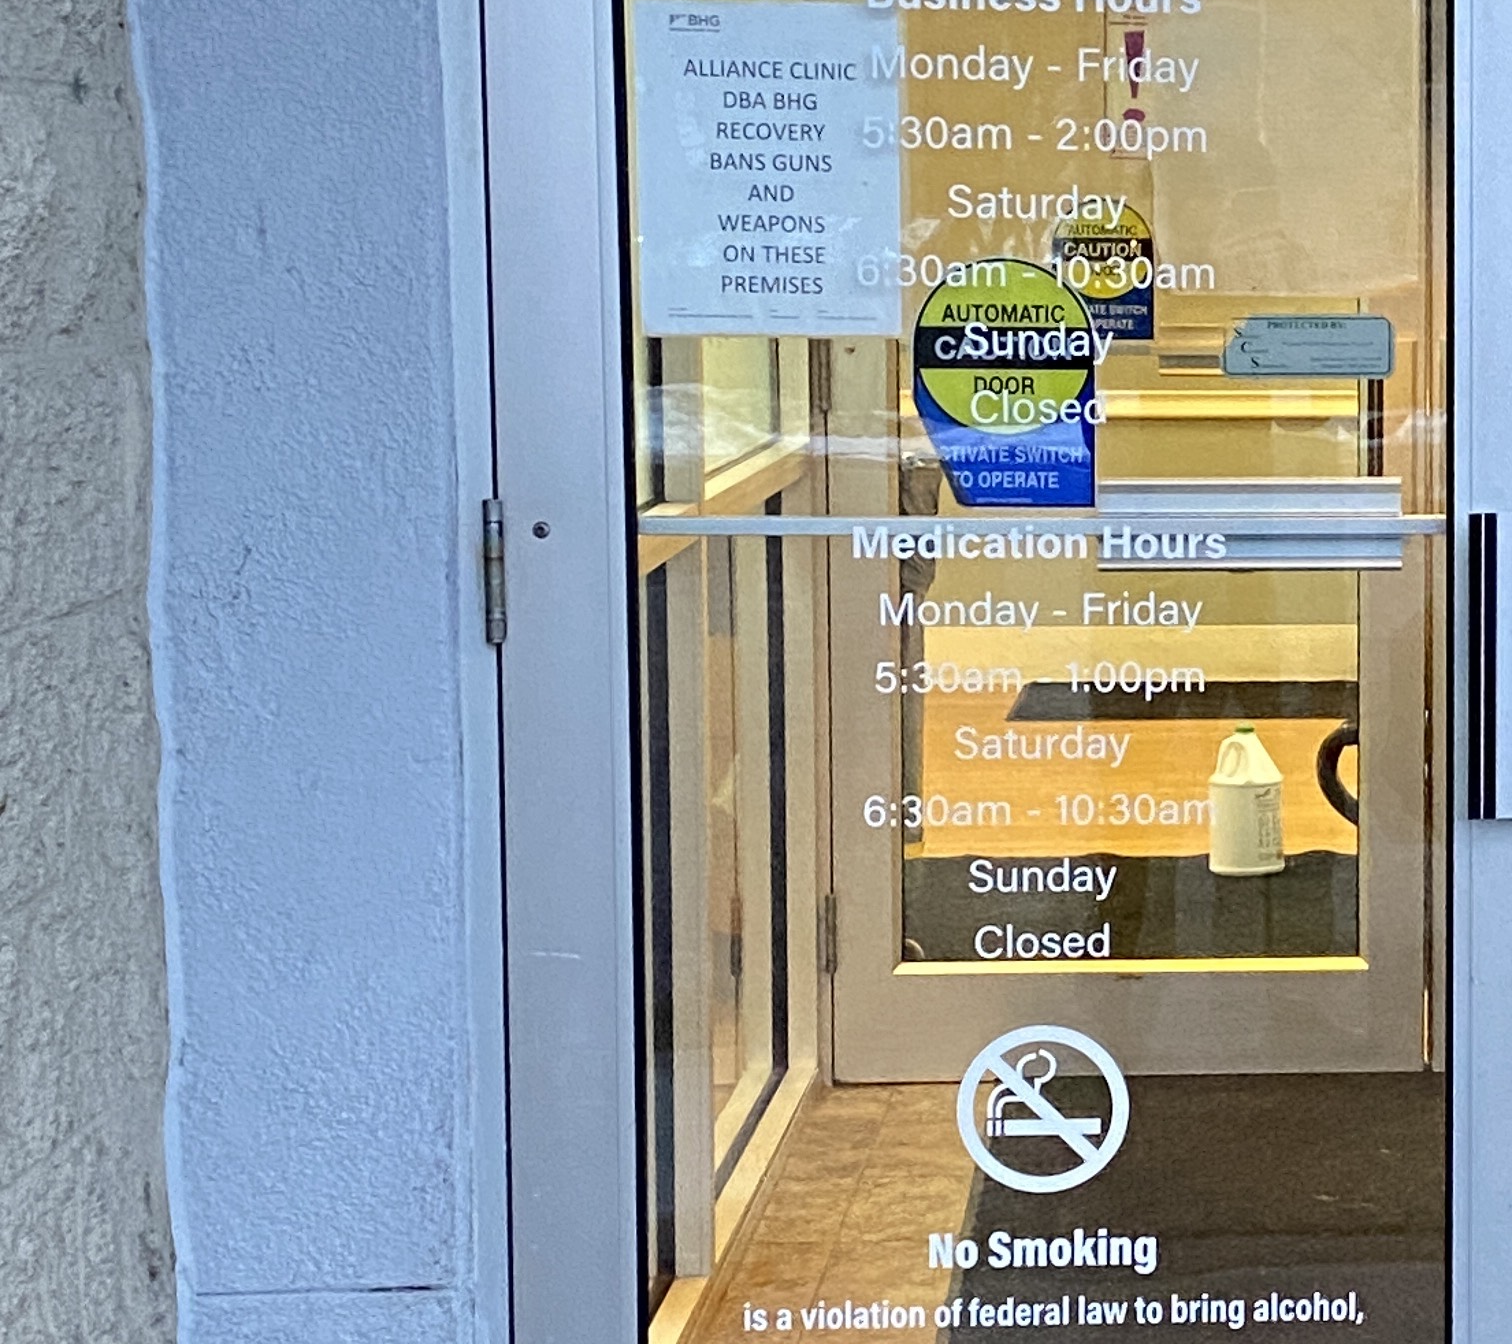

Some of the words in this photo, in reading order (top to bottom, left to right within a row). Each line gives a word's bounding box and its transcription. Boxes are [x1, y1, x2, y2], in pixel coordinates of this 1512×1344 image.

[688, 14, 720, 27] BHG
[683, 59, 783, 80] ALLIANCE
[790, 62, 857, 81] CLINIC
[871, 44, 1034, 91] Monday
[1077, 47, 1199, 93] Friday
[723, 92, 766, 110] DBA
[773, 93, 818, 110] BHG
[716, 122, 826, 141] RECOVERY
[862, 115, 1013, 150] 5:30am
[1055, 118, 1208, 160] 2:00pm
[710, 153, 766, 171] BANS
[773, 155, 832, 172] GUNS
[748, 185, 795, 203] AND
[947, 184, 1127, 230] Saturday
[718, 215, 826, 234] WEAPONS
[723, 244, 756, 263] ON
[762, 245, 826, 264] THESE
[1064, 242, 1142, 257] CAUTION
[721, 276, 824, 295] PREMISES
[857, 253, 1008, 289] 6:30am
[1051, 256, 1216, 290] 10:30am
[941, 303, 1066, 324] AUTOMATIC
[1094, 319, 1135, 330] PERATE
[964, 321, 1114, 365] Sunday
[973, 376, 1035, 395] DOOR
[970, 388, 1107, 424] Closed
[1014, 446, 1083, 464] SWITCH
[978, 471, 1060, 489] OPERATE
[852, 525, 1087, 559] Medication
[1102, 526, 1226, 559] Hours
[880, 591, 1039, 632] Monday
[1083, 591, 1203, 632] Friday
[875, 661, 1022, 694] 5:30am
[1067, 662, 1206, 701] 1:00pm
[953, 726, 1132, 768] Saturday
[863, 794, 1012, 828] 6:30am
[1055, 793, 1217, 827] 10:30am
[968, 857, 1117, 901] Sunday
[974, 922, 1112, 959] Closed
[927, 1231, 977, 1270] No
[988, 1227, 1159, 1276] Smoking
[743, 1301, 767, 1331] is
[775, 1310, 793, 1331] a
[800, 1298, 926, 1330] violation
[934, 1297, 963, 1328] of
[967, 1294, 1070, 1328] federal
[1078, 1294, 1127, 1325] law
[1135, 1296, 1163, 1325] to
[1170, 1292, 1245, 1330] bring
[1252, 1291, 1365, 1326] alcohol,
